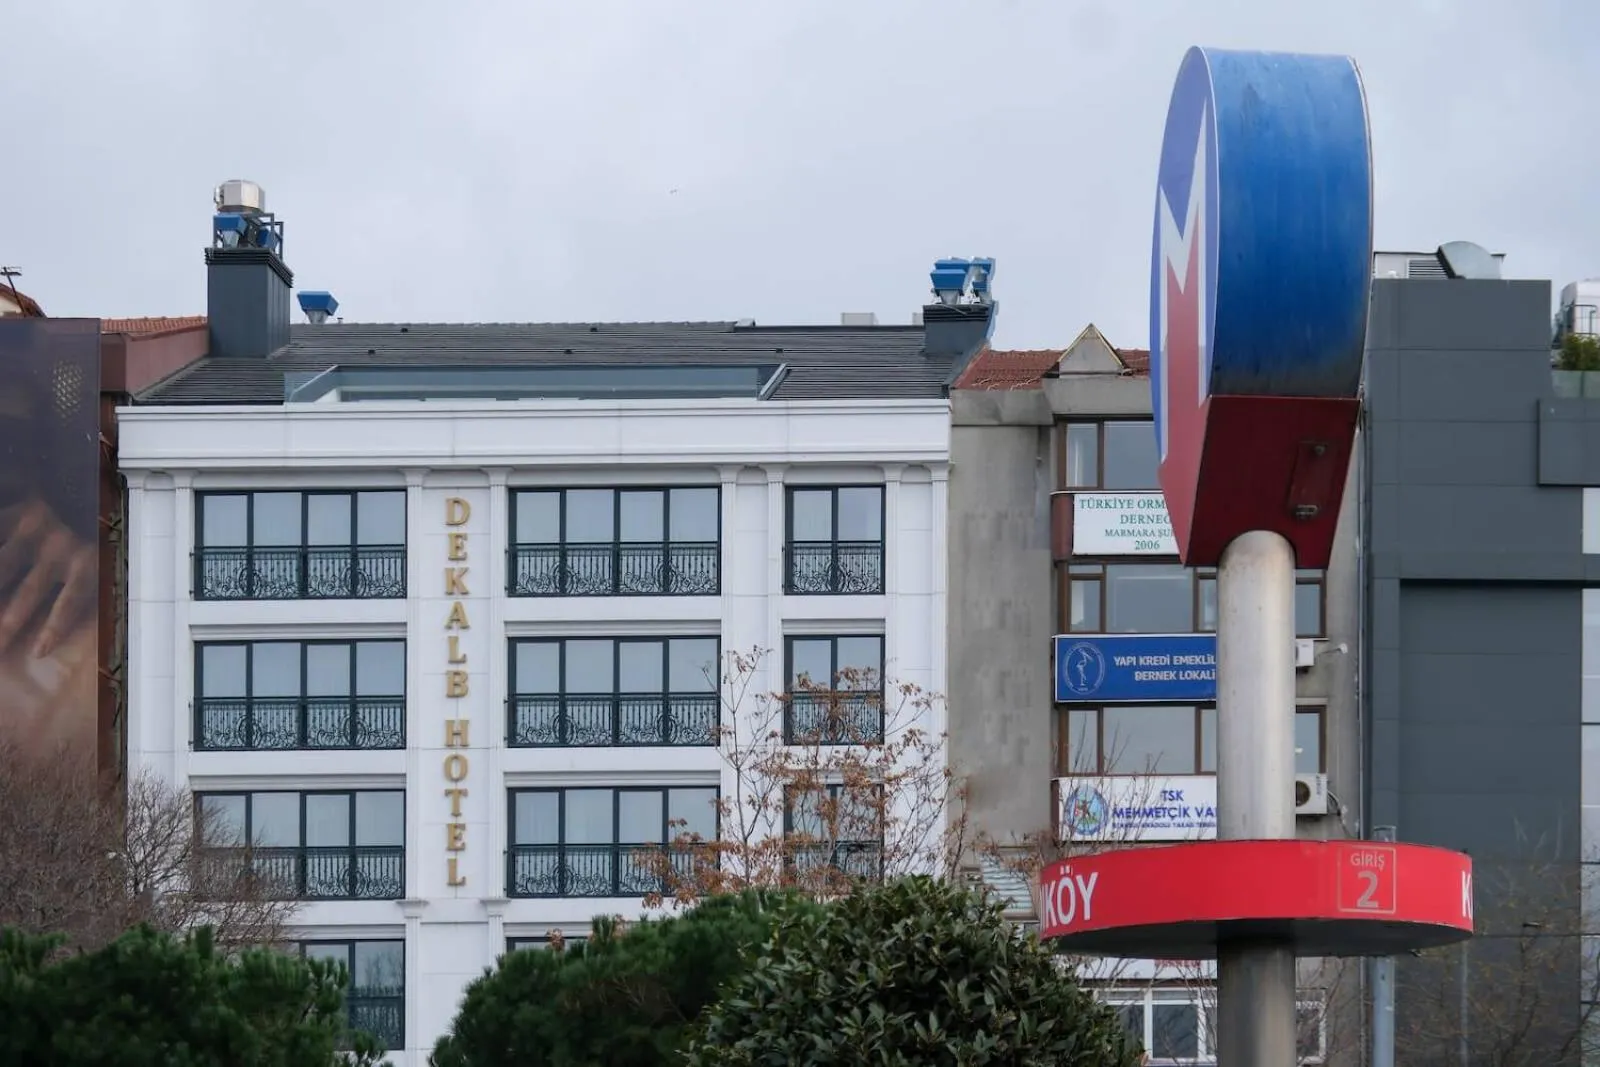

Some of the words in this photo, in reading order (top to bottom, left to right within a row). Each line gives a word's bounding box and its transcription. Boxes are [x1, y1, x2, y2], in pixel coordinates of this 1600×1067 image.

[1079, 497, 1134, 509] TÜRKİYE
[1137, 499, 1165, 509] ORM
[1105, 529, 1155, 537] MARMARA
[1135, 540, 1160, 550] 2006
[444, 497, 471, 698] DEKALB
[1113, 655, 1136, 666] YAPI
[1139, 654, 1170, 666] KREDİ
[1173, 654, 1216, 665] EMEKLİL
[1179, 669, 1215, 680] LOKALİ
[1161, 789, 1184, 801] TSK
[444, 719, 470, 887] HOTEL
[1112, 805, 1191, 820] MEHMETÇİK
[1195, 806, 1217, 818] VA
[1350, 850, 1385, 872] GİRİŞ
[1357, 870, 1378, 908] 2
[1462, 870, 1473, 920] K
